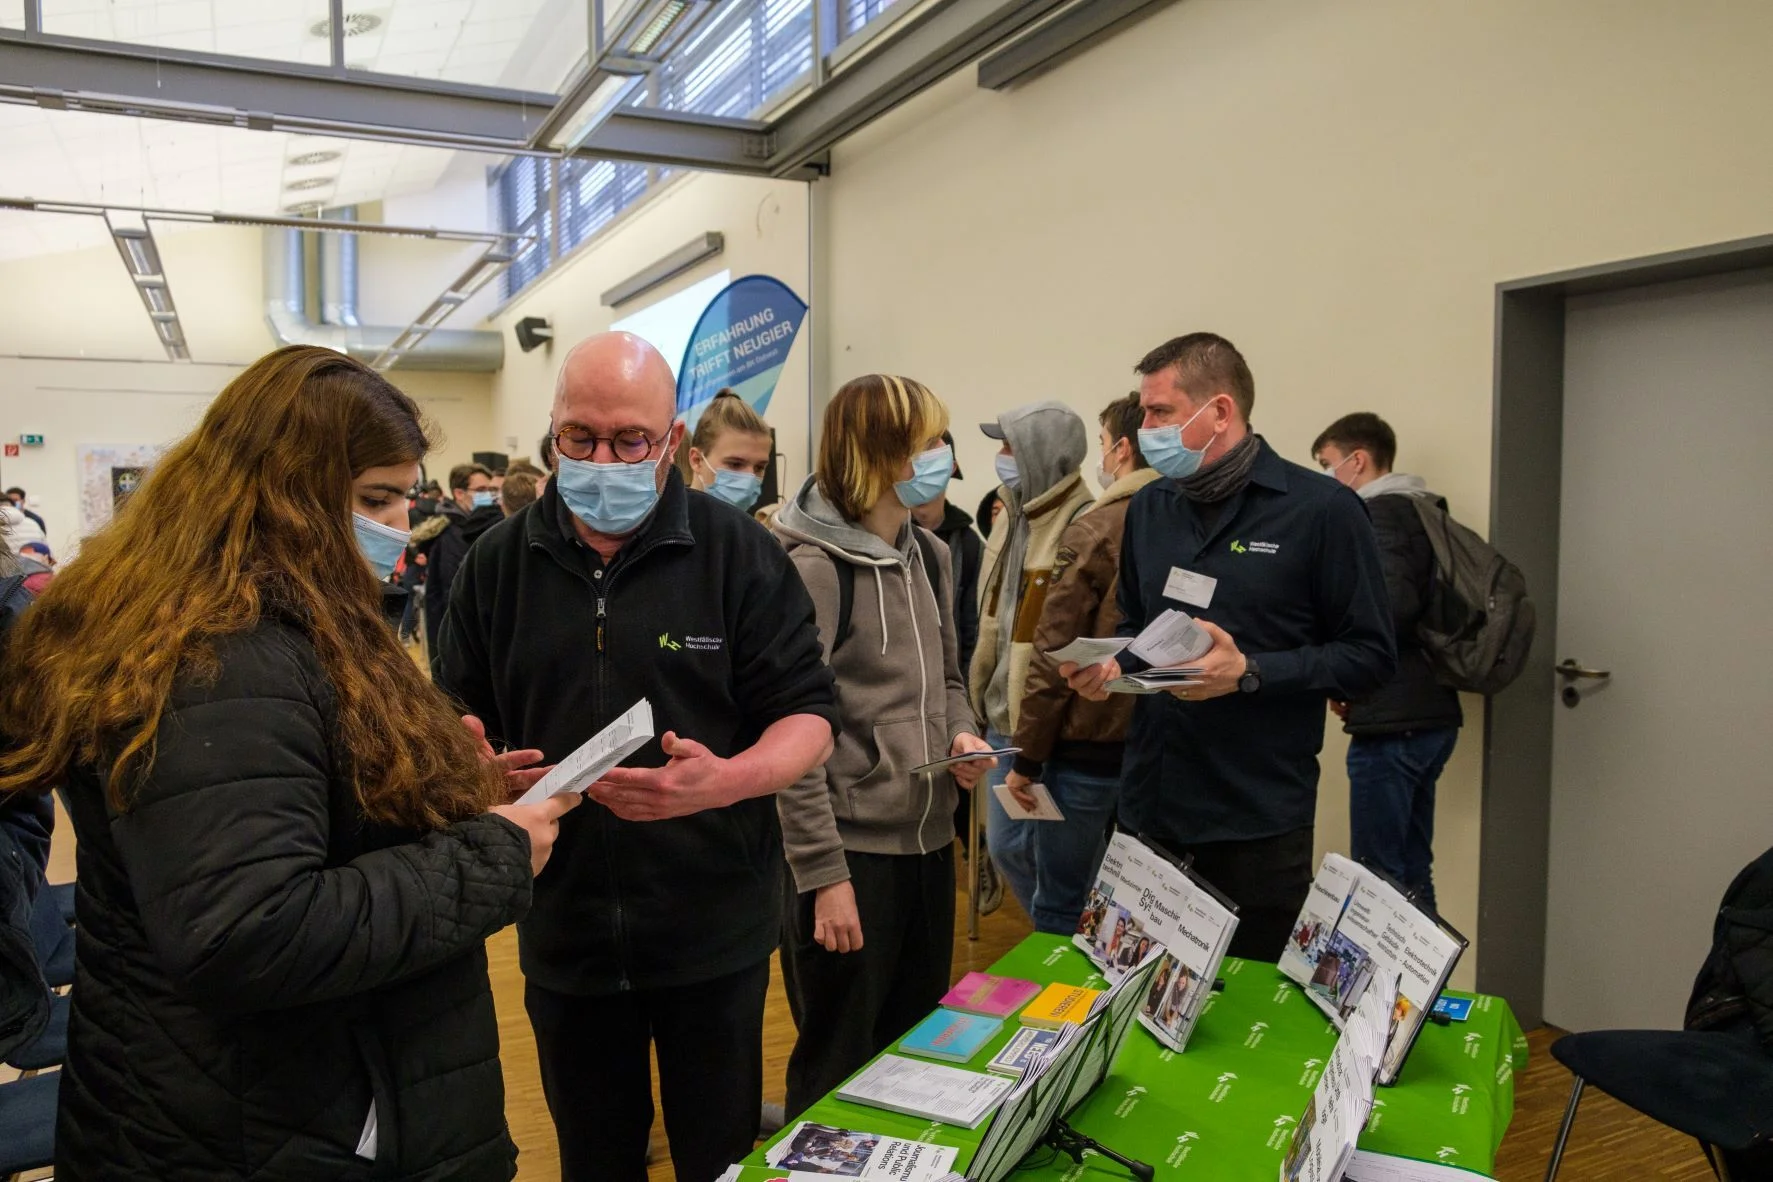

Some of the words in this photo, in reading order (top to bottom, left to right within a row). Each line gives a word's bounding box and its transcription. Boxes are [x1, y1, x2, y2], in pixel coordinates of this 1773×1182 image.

[694, 307, 775, 357] ERFAHRUNG
[688, 350, 731, 378] TRIFFT
[733, 320, 793, 360] NEUGIER
[1178, 923, 1210, 953] Mechatronik
[1402, 960, 1430, 985] Automation
[1403, 946, 1437, 976] Elektrotechnik
[878, 1141, 902, 1170] Relations
[889, 1155, 908, 1176] Public
